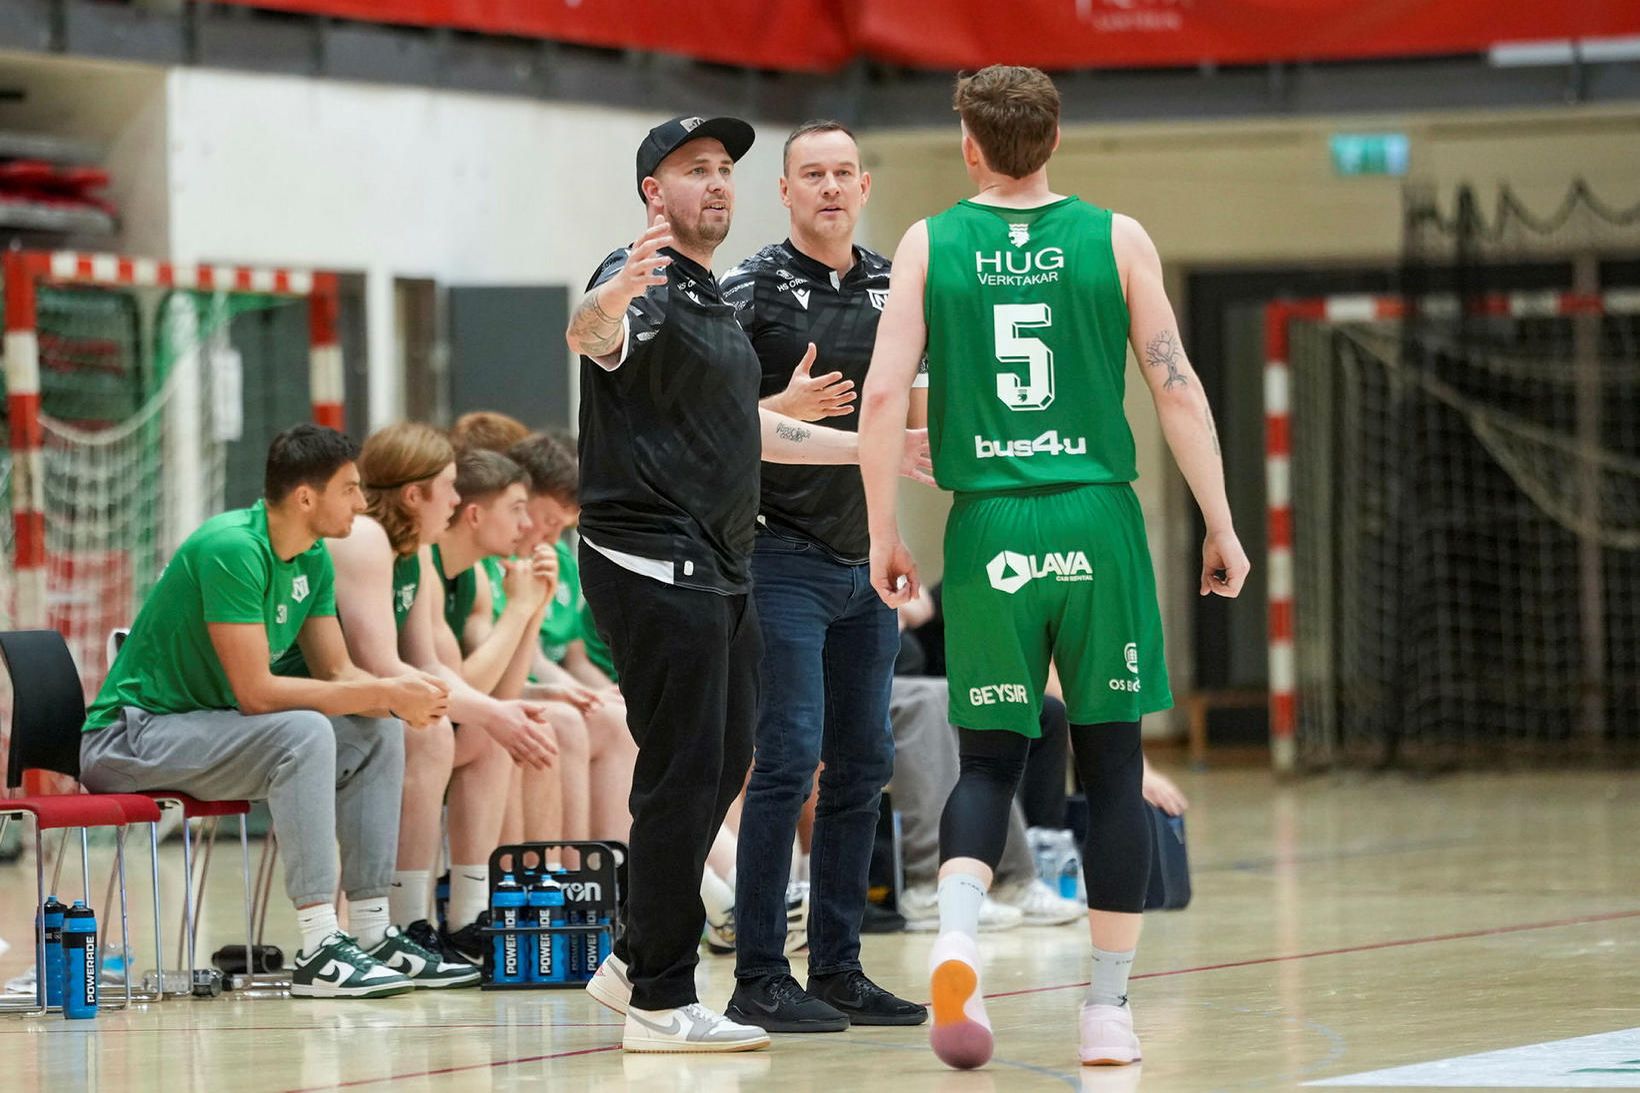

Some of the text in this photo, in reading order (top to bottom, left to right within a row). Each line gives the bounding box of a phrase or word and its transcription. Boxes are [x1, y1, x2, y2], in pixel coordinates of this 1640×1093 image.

[976, 247, 1064, 274] HUG
[977, 271, 1059, 286] VERKTAKAR
[993, 303, 1055, 411] 5
[974, 430, 1087, 458] bus4u
[1029, 551, 1093, 578] LAVA
[969, 683, 1028, 706] GEYSIR
[1109, 679, 1125, 691] OS
[505, 910, 517, 974] POWERDE
[539, 909, 551, 974] POWERDE
[86, 936, 95, 1003] POWERADE
